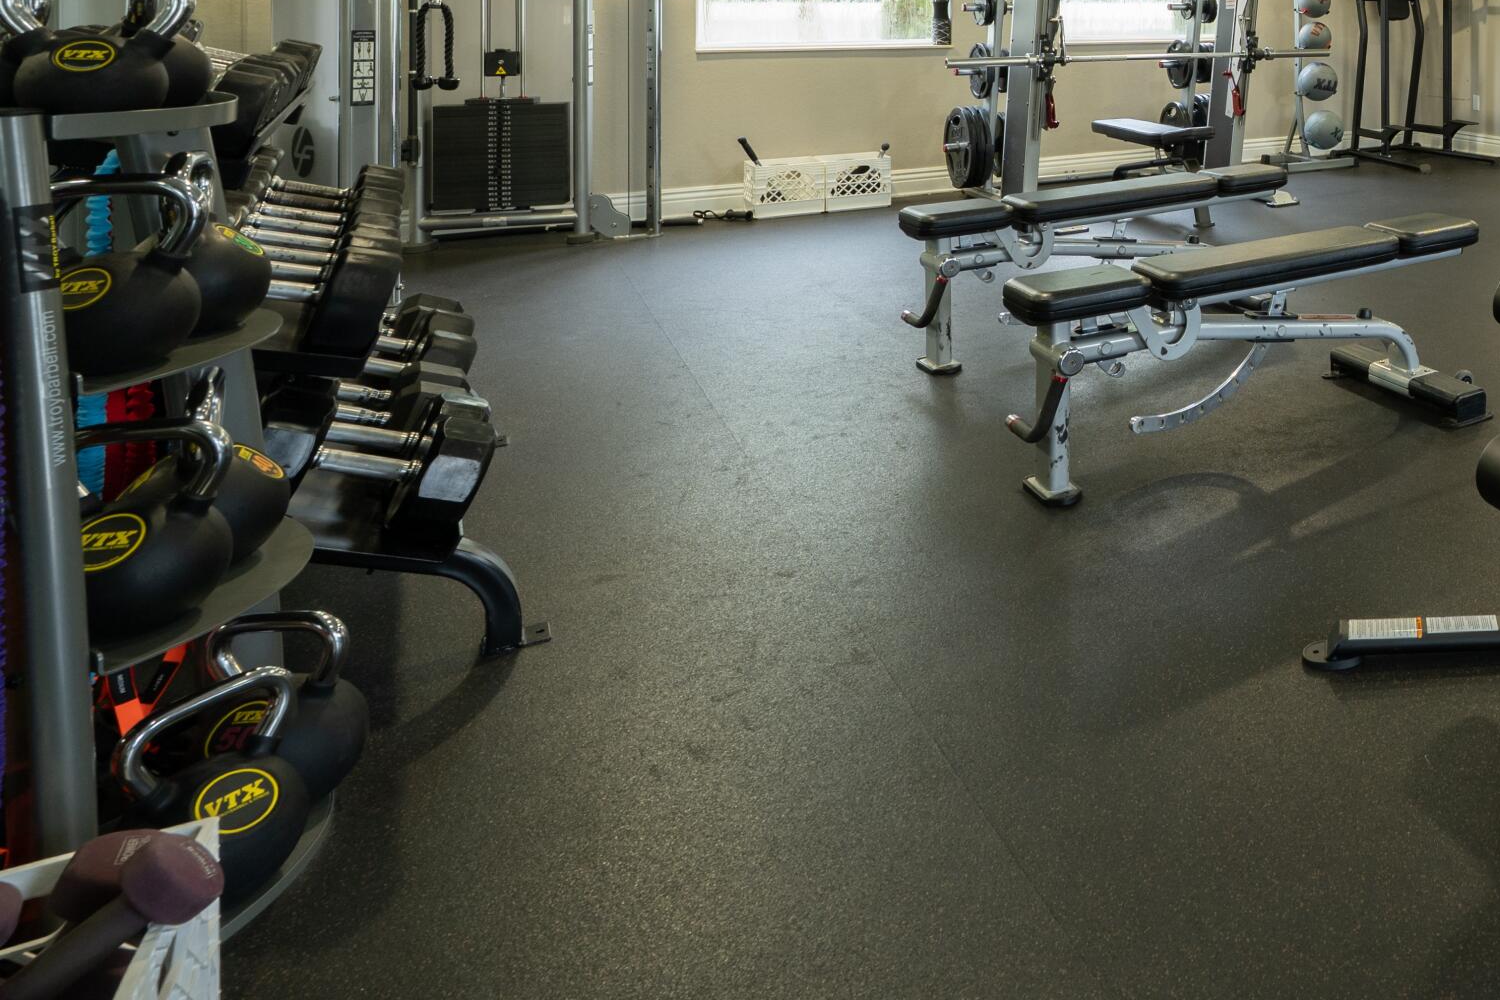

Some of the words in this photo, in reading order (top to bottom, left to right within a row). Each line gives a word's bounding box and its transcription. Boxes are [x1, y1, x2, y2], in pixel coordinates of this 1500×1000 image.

[64, 49, 109, 58] VTX
[52, 245, 60, 267] TROY
[61, 280, 106, 293] VTX
[81, 530, 138, 547] VTX
[204, 778, 266, 817] VTX
